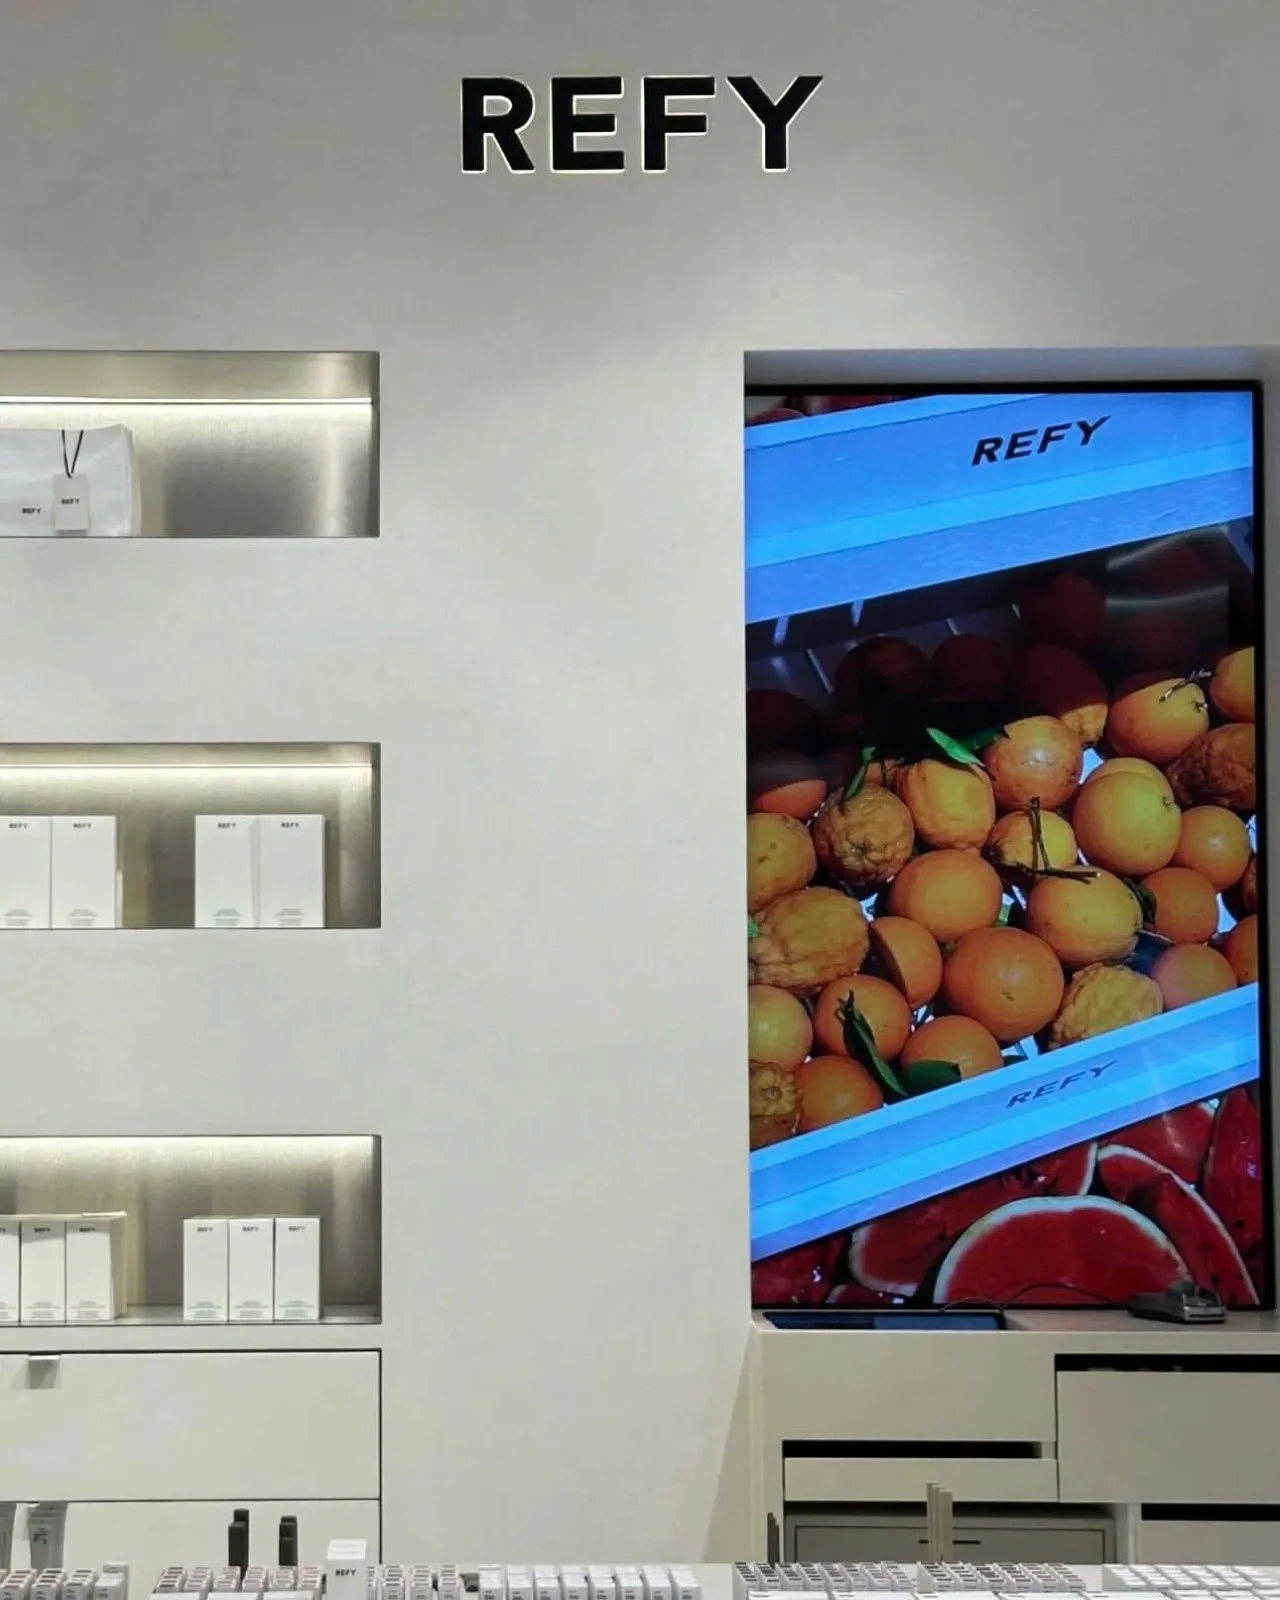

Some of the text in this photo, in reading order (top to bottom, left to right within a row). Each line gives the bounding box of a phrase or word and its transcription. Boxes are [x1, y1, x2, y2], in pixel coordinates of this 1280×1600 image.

[461, 75, 824, 173] REFY
[971, 415, 1111, 467] REFY
[1005, 1060, 1118, 1109] REFY
